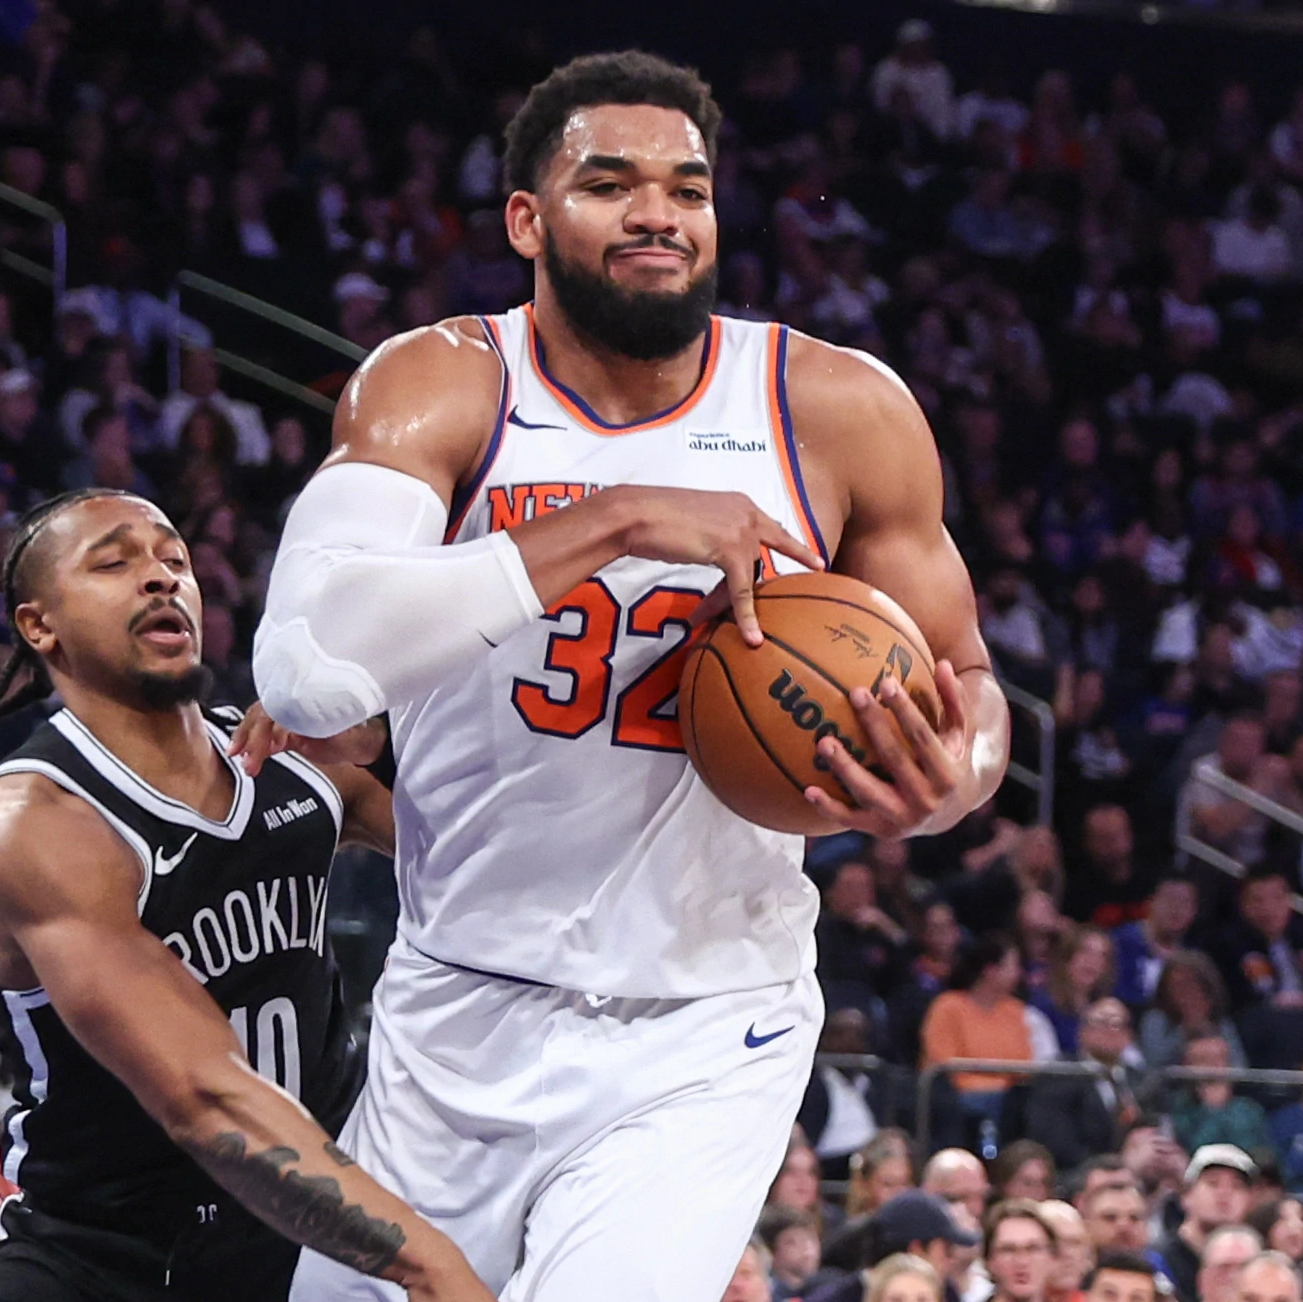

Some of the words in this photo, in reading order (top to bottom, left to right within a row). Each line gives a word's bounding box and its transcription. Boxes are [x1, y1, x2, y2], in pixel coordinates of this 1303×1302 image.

[689, 440, 718, 451] abu
[721, 439, 767, 452] dhabi
[511, 577, 706, 754] 32
[263, 810, 282, 831] All
[286, 797, 318, 818] Won
[162, 875, 331, 985] ROOKLYN
